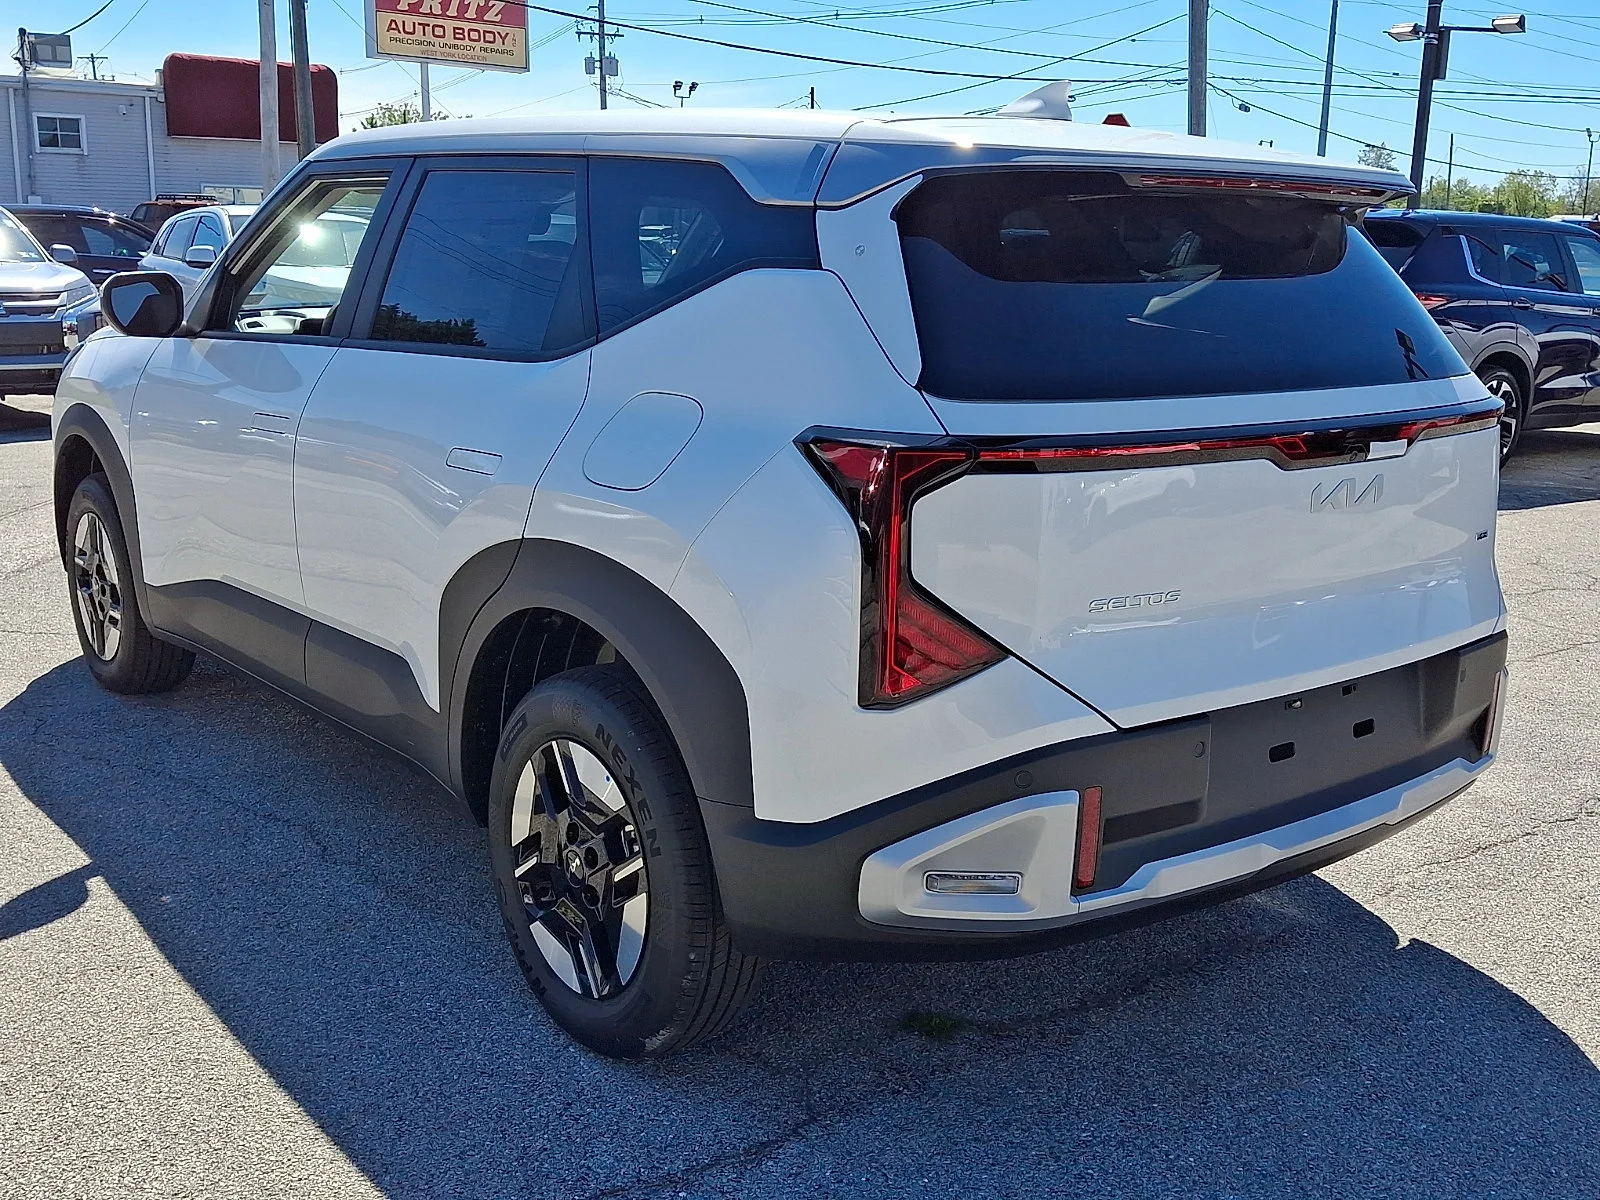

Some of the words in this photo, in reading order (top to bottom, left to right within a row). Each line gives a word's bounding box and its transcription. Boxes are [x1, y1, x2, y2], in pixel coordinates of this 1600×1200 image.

[386, 19, 446, 38] AUTO
[453, 27, 509, 45] BODY
[389, 36, 435, 47] PRECISION
[438, 41, 476, 52] UNIBODY
[480, 46, 515, 56] REPAIRS
[457, 53, 487, 61] LOCATION
[1088, 589, 1181, 613] SELTOS
[595, 723, 661, 857] NEXEN
